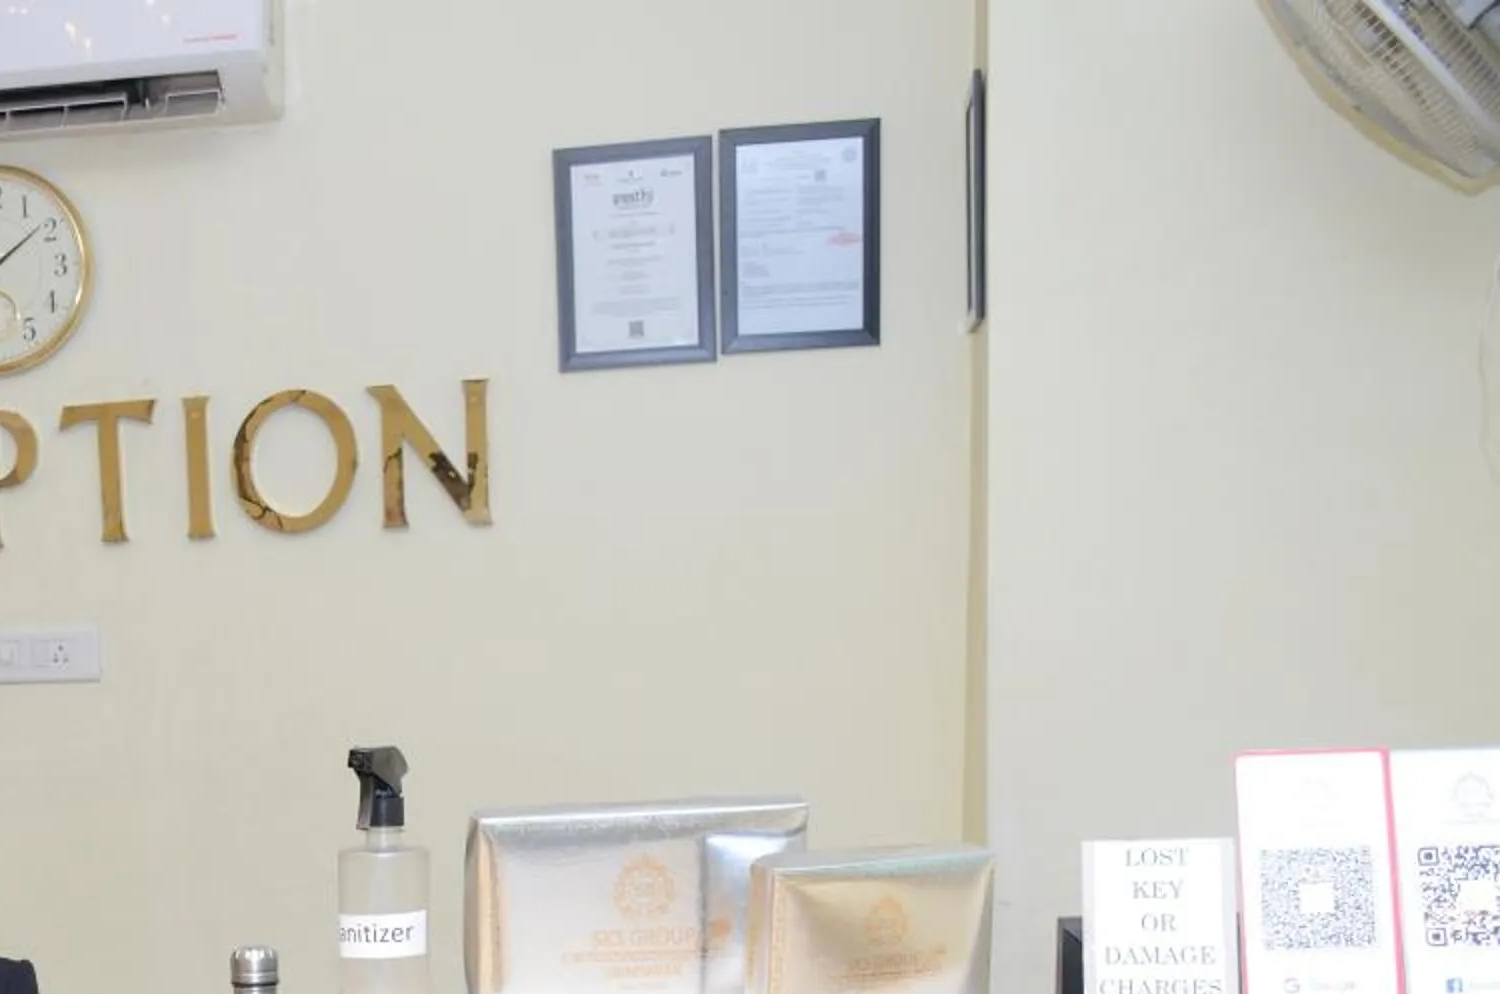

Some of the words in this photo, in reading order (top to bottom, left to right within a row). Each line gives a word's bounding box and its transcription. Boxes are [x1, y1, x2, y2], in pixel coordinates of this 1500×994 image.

[21, 195, 28, 219] 1
[43, 217, 58, 243] 2
[53, 253, 68, 277] 3
[23, 317, 37, 341] 5
[1125, 847, 1188, 868] LOST
[1132, 879, 1184, 900] KEY
[1141, 913, 1178, 933] OR
[630, 926, 696, 947] GROUP
[1104, 945, 1217, 966] DAMAGE
